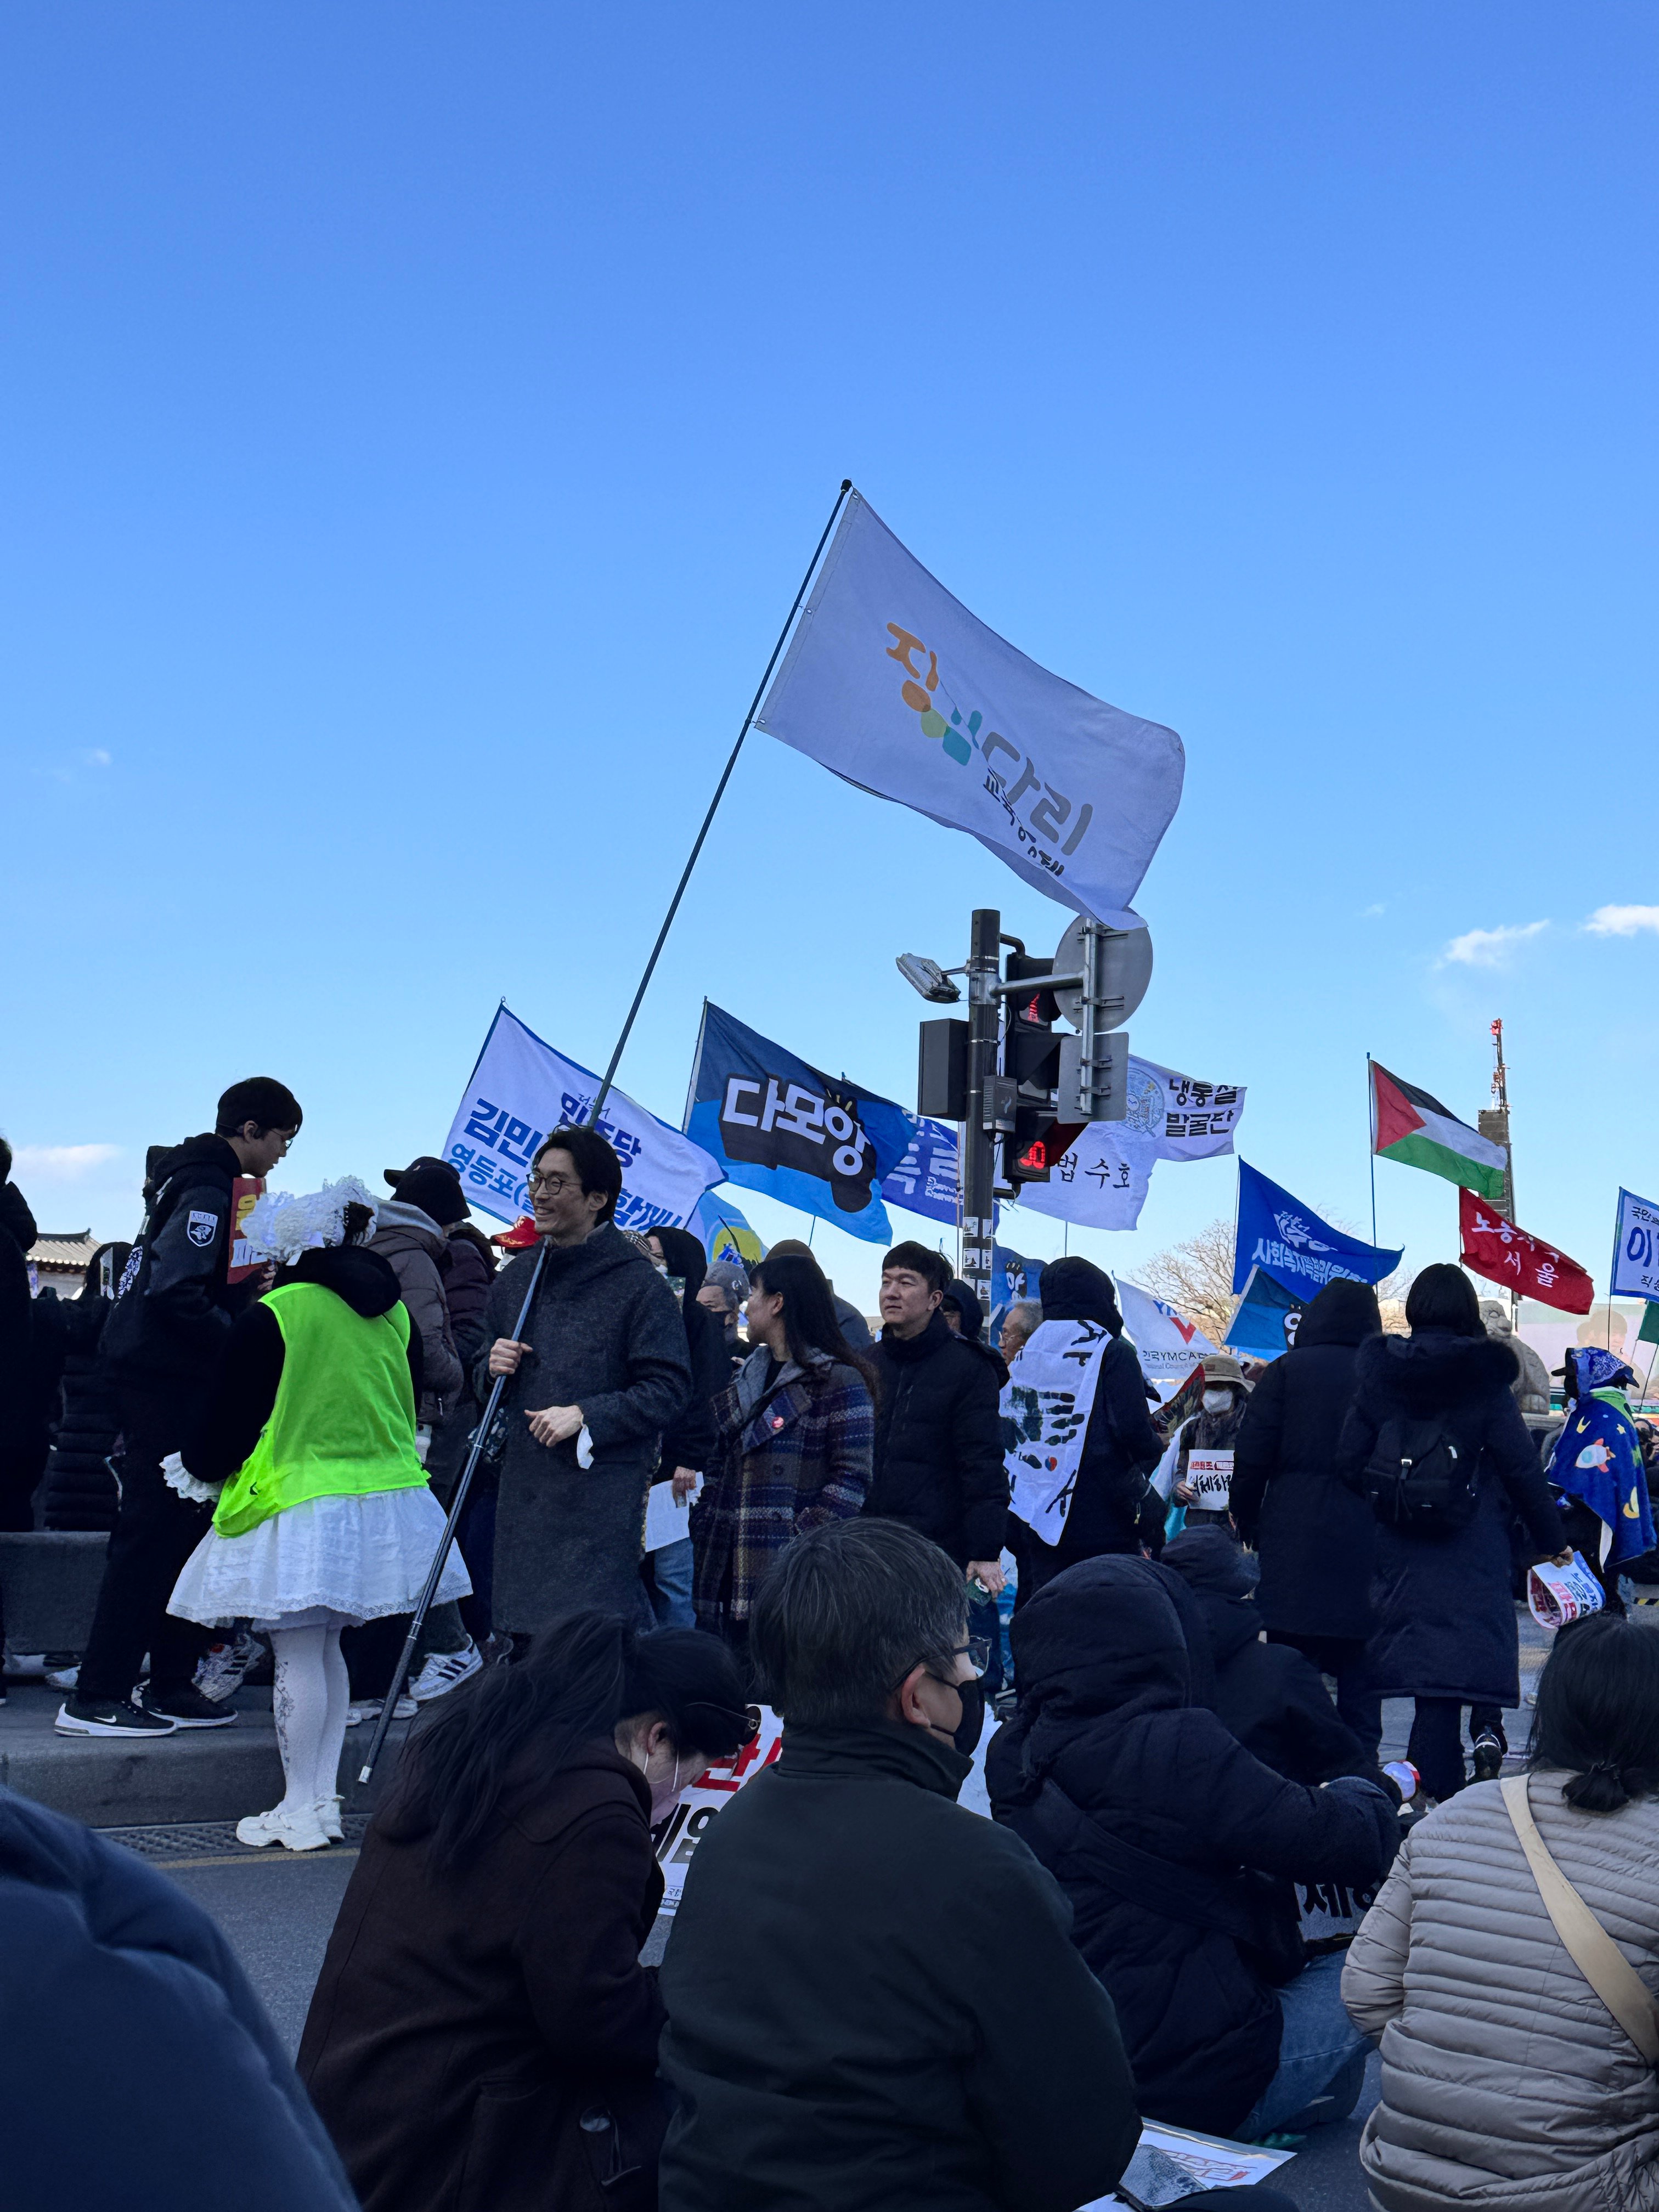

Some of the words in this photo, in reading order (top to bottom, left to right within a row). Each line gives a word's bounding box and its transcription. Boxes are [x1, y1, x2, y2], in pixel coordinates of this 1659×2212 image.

[558, 1092, 642, 1168] 민당
[722, 1077, 872, 1176] 다모앙
[1627, 1226, 1658, 1267] 이
